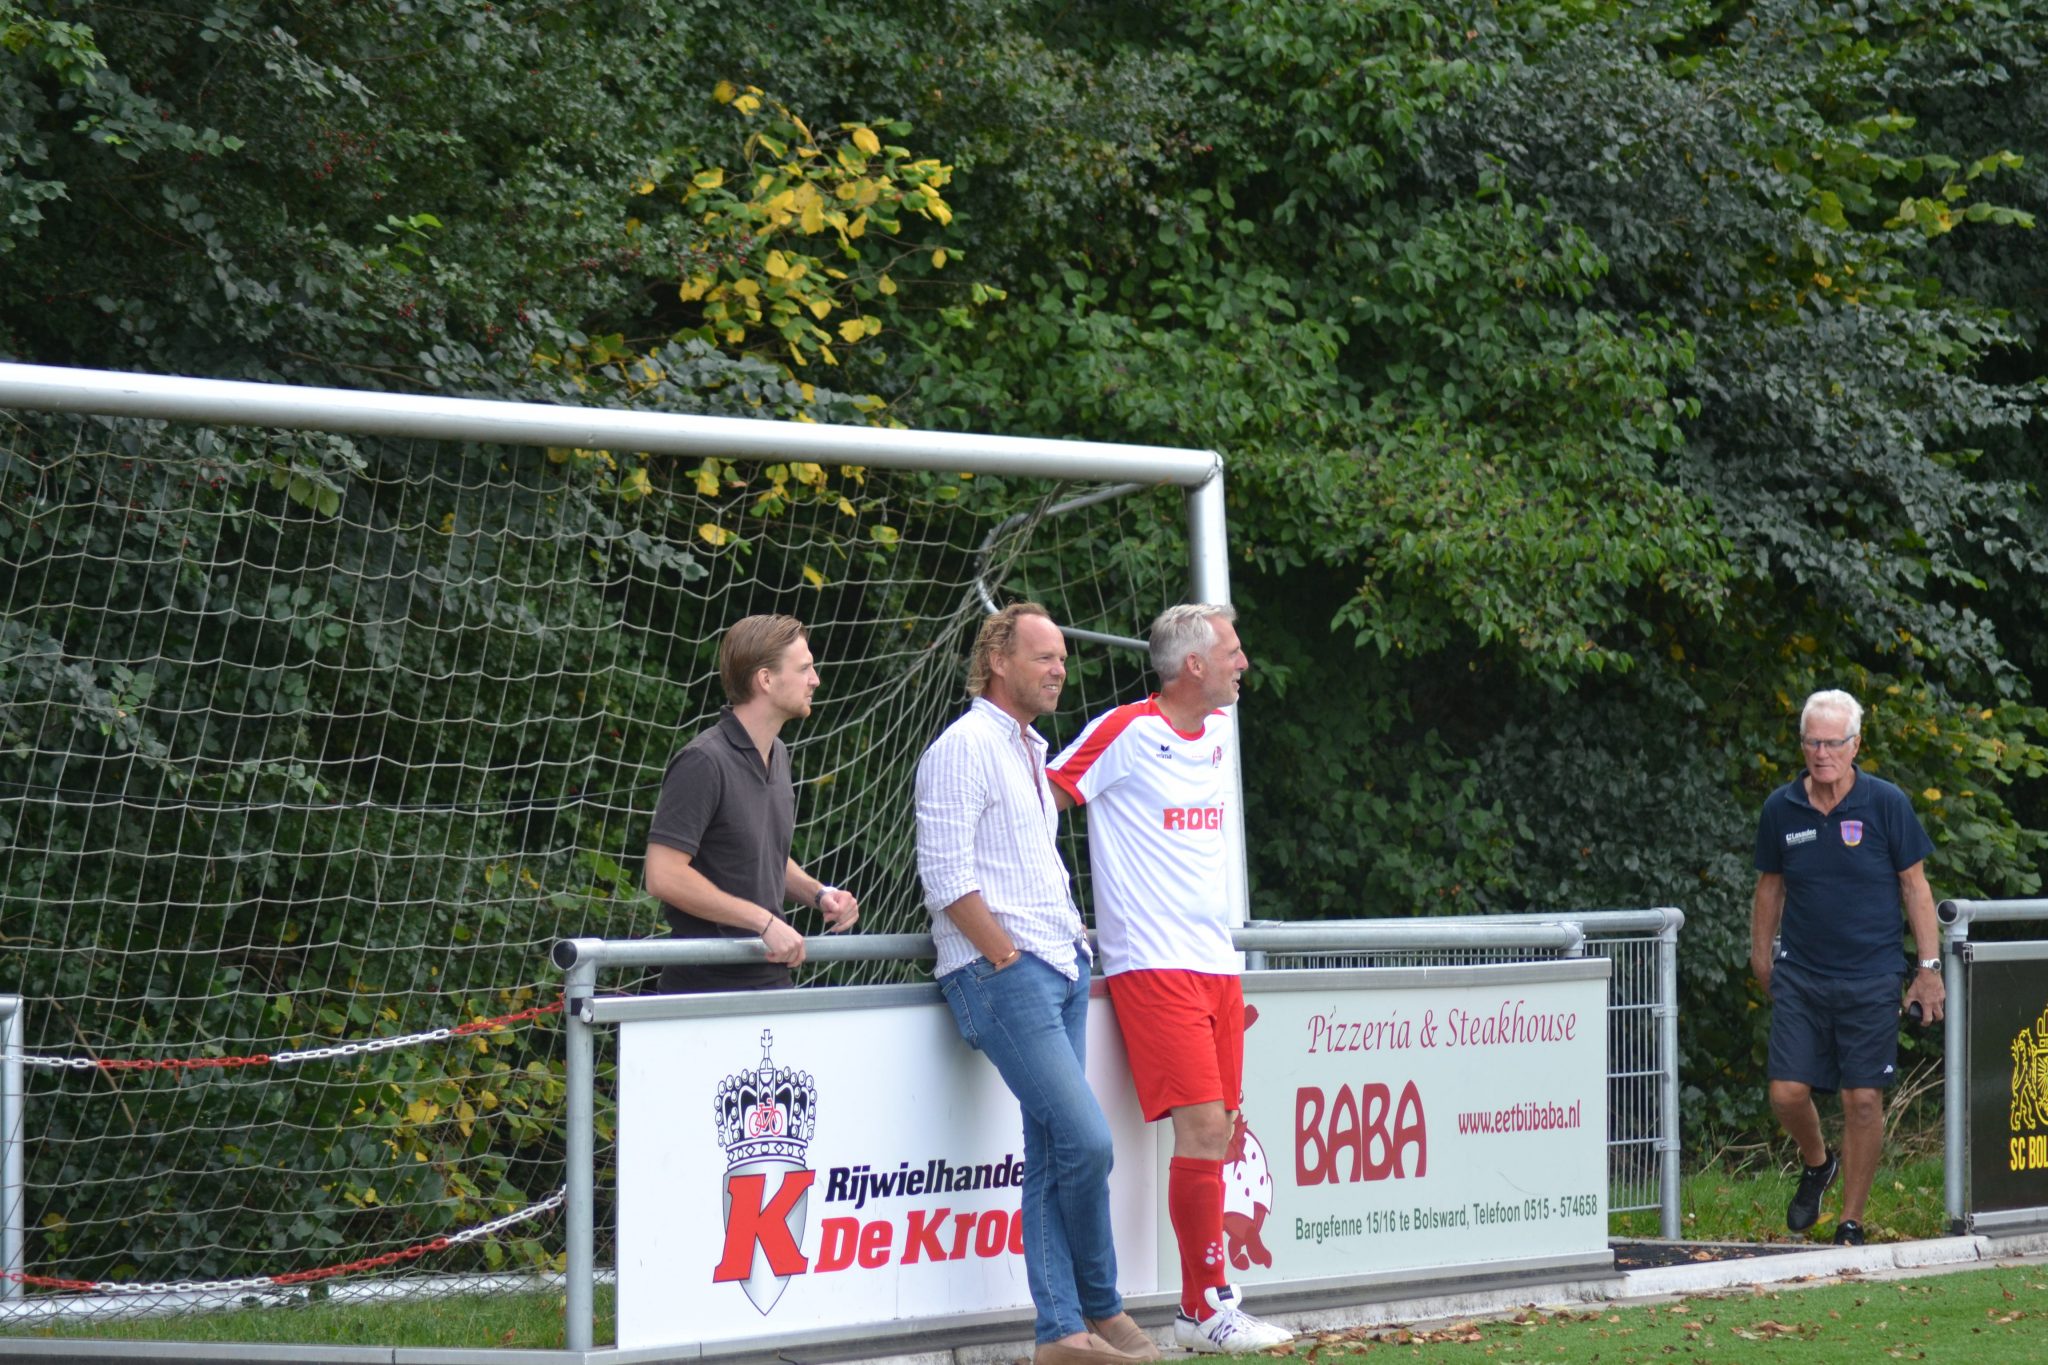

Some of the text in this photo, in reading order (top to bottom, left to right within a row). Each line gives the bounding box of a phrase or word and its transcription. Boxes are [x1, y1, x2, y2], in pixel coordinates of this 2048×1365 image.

[1308, 1000, 1576, 1053] Pizzeria & Steakhouse
[1295, 1079, 1427, 1187] BABA
[1458, 1099, 1581, 1135] www.eetbijbaba.nl
[2011, 1137, 2026, 1171] SC
[712, 1169, 816, 1283] K
[814, 1216, 893, 1273] De
[1295, 1214, 1362, 1244] Bargefenne
[1366, 1210, 1396, 1234] 15/16
[1400, 1209, 1410, 1231] te
[1414, 1204, 1470, 1230] Bolsward,
[1473, 1201, 1521, 1224] Telefoon
[1524, 1198, 1549, 1221] 0515
[1560, 1194, 1598, 1218] 574658
